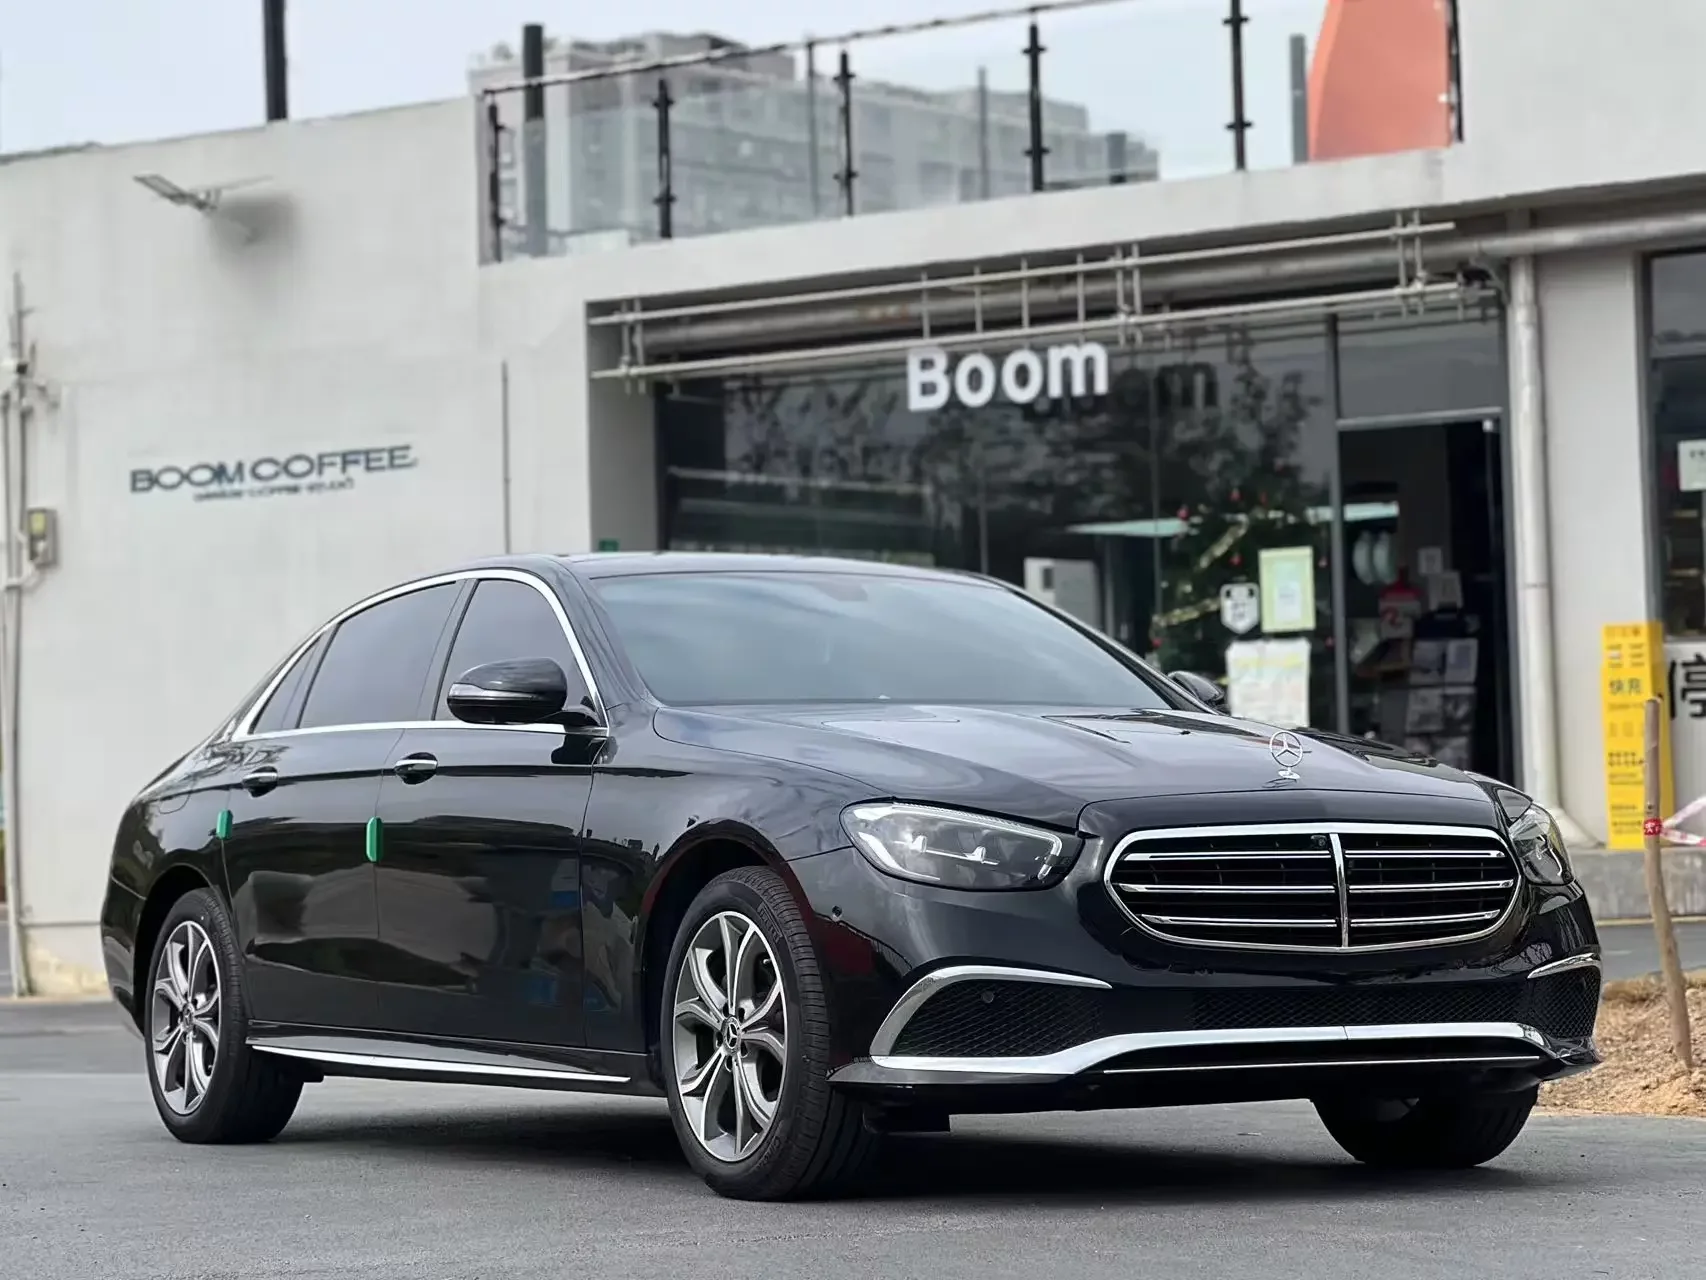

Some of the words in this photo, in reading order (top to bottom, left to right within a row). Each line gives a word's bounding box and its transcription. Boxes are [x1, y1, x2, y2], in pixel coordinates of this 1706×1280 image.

[906, 342, 1109, 412] Boom
[129, 461, 245, 493] BOOM
[250, 444, 417, 481] COFFEE
